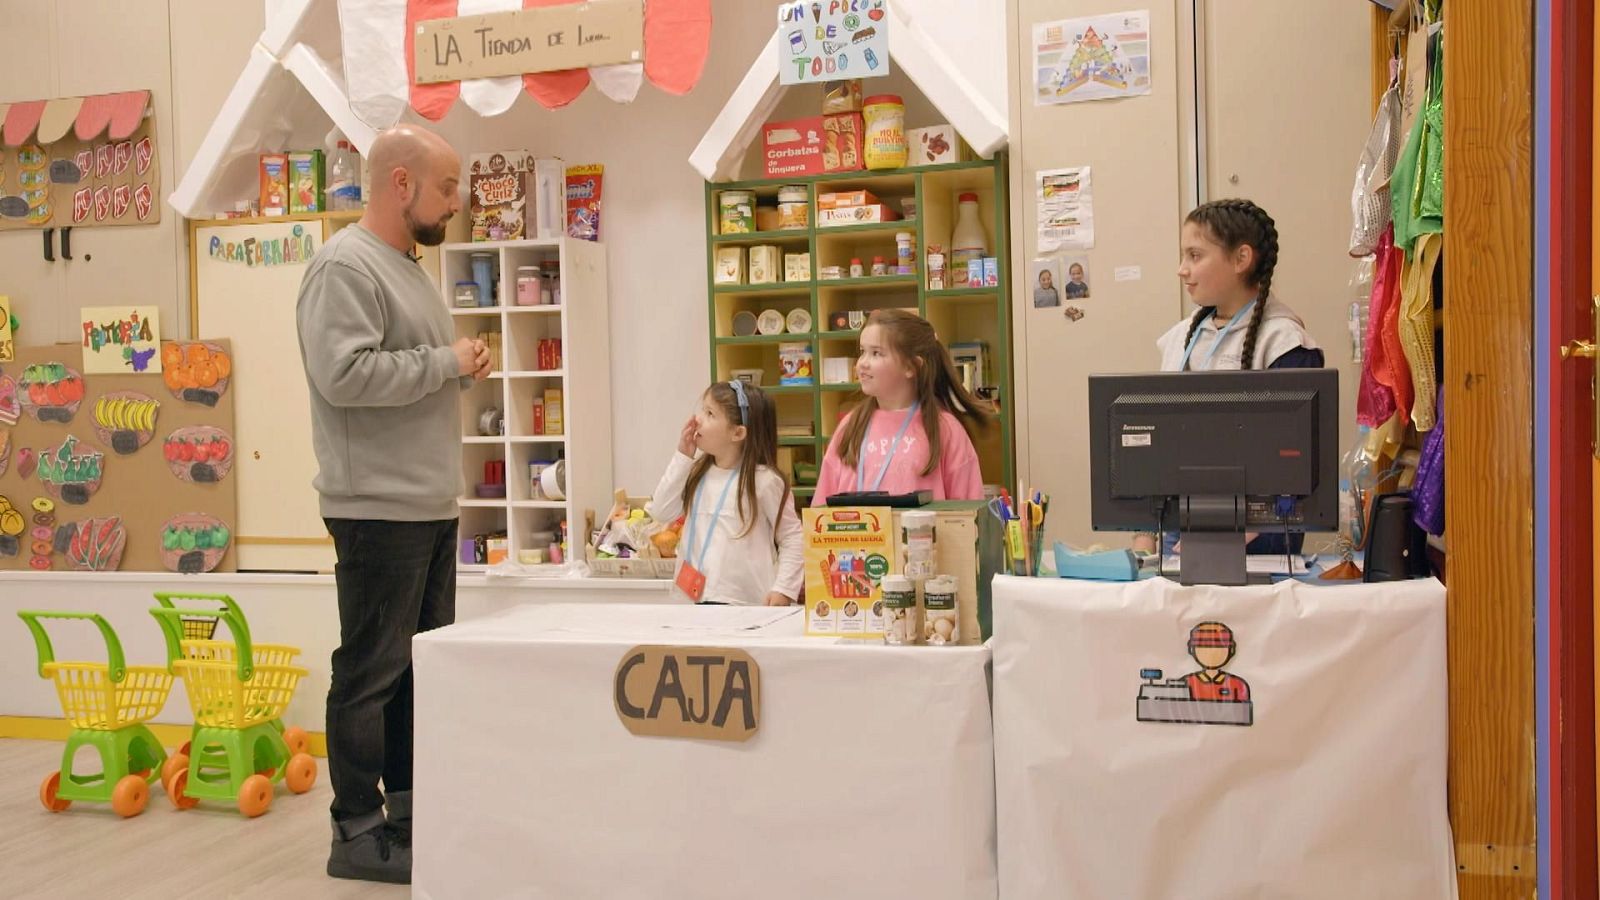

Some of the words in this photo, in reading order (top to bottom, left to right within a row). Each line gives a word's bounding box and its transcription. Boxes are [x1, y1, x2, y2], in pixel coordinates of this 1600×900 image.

[829, 0, 869, 15] POCO
[815, 25, 837, 40] DE
[433, 33, 462, 66] LA
[548, 32, 564, 47] DE
[792, 53, 848, 80] TODO
[481, 178, 514, 192] Choco
[485, 189, 513, 202] Curlz
[616, 653, 756, 731] CAJA
